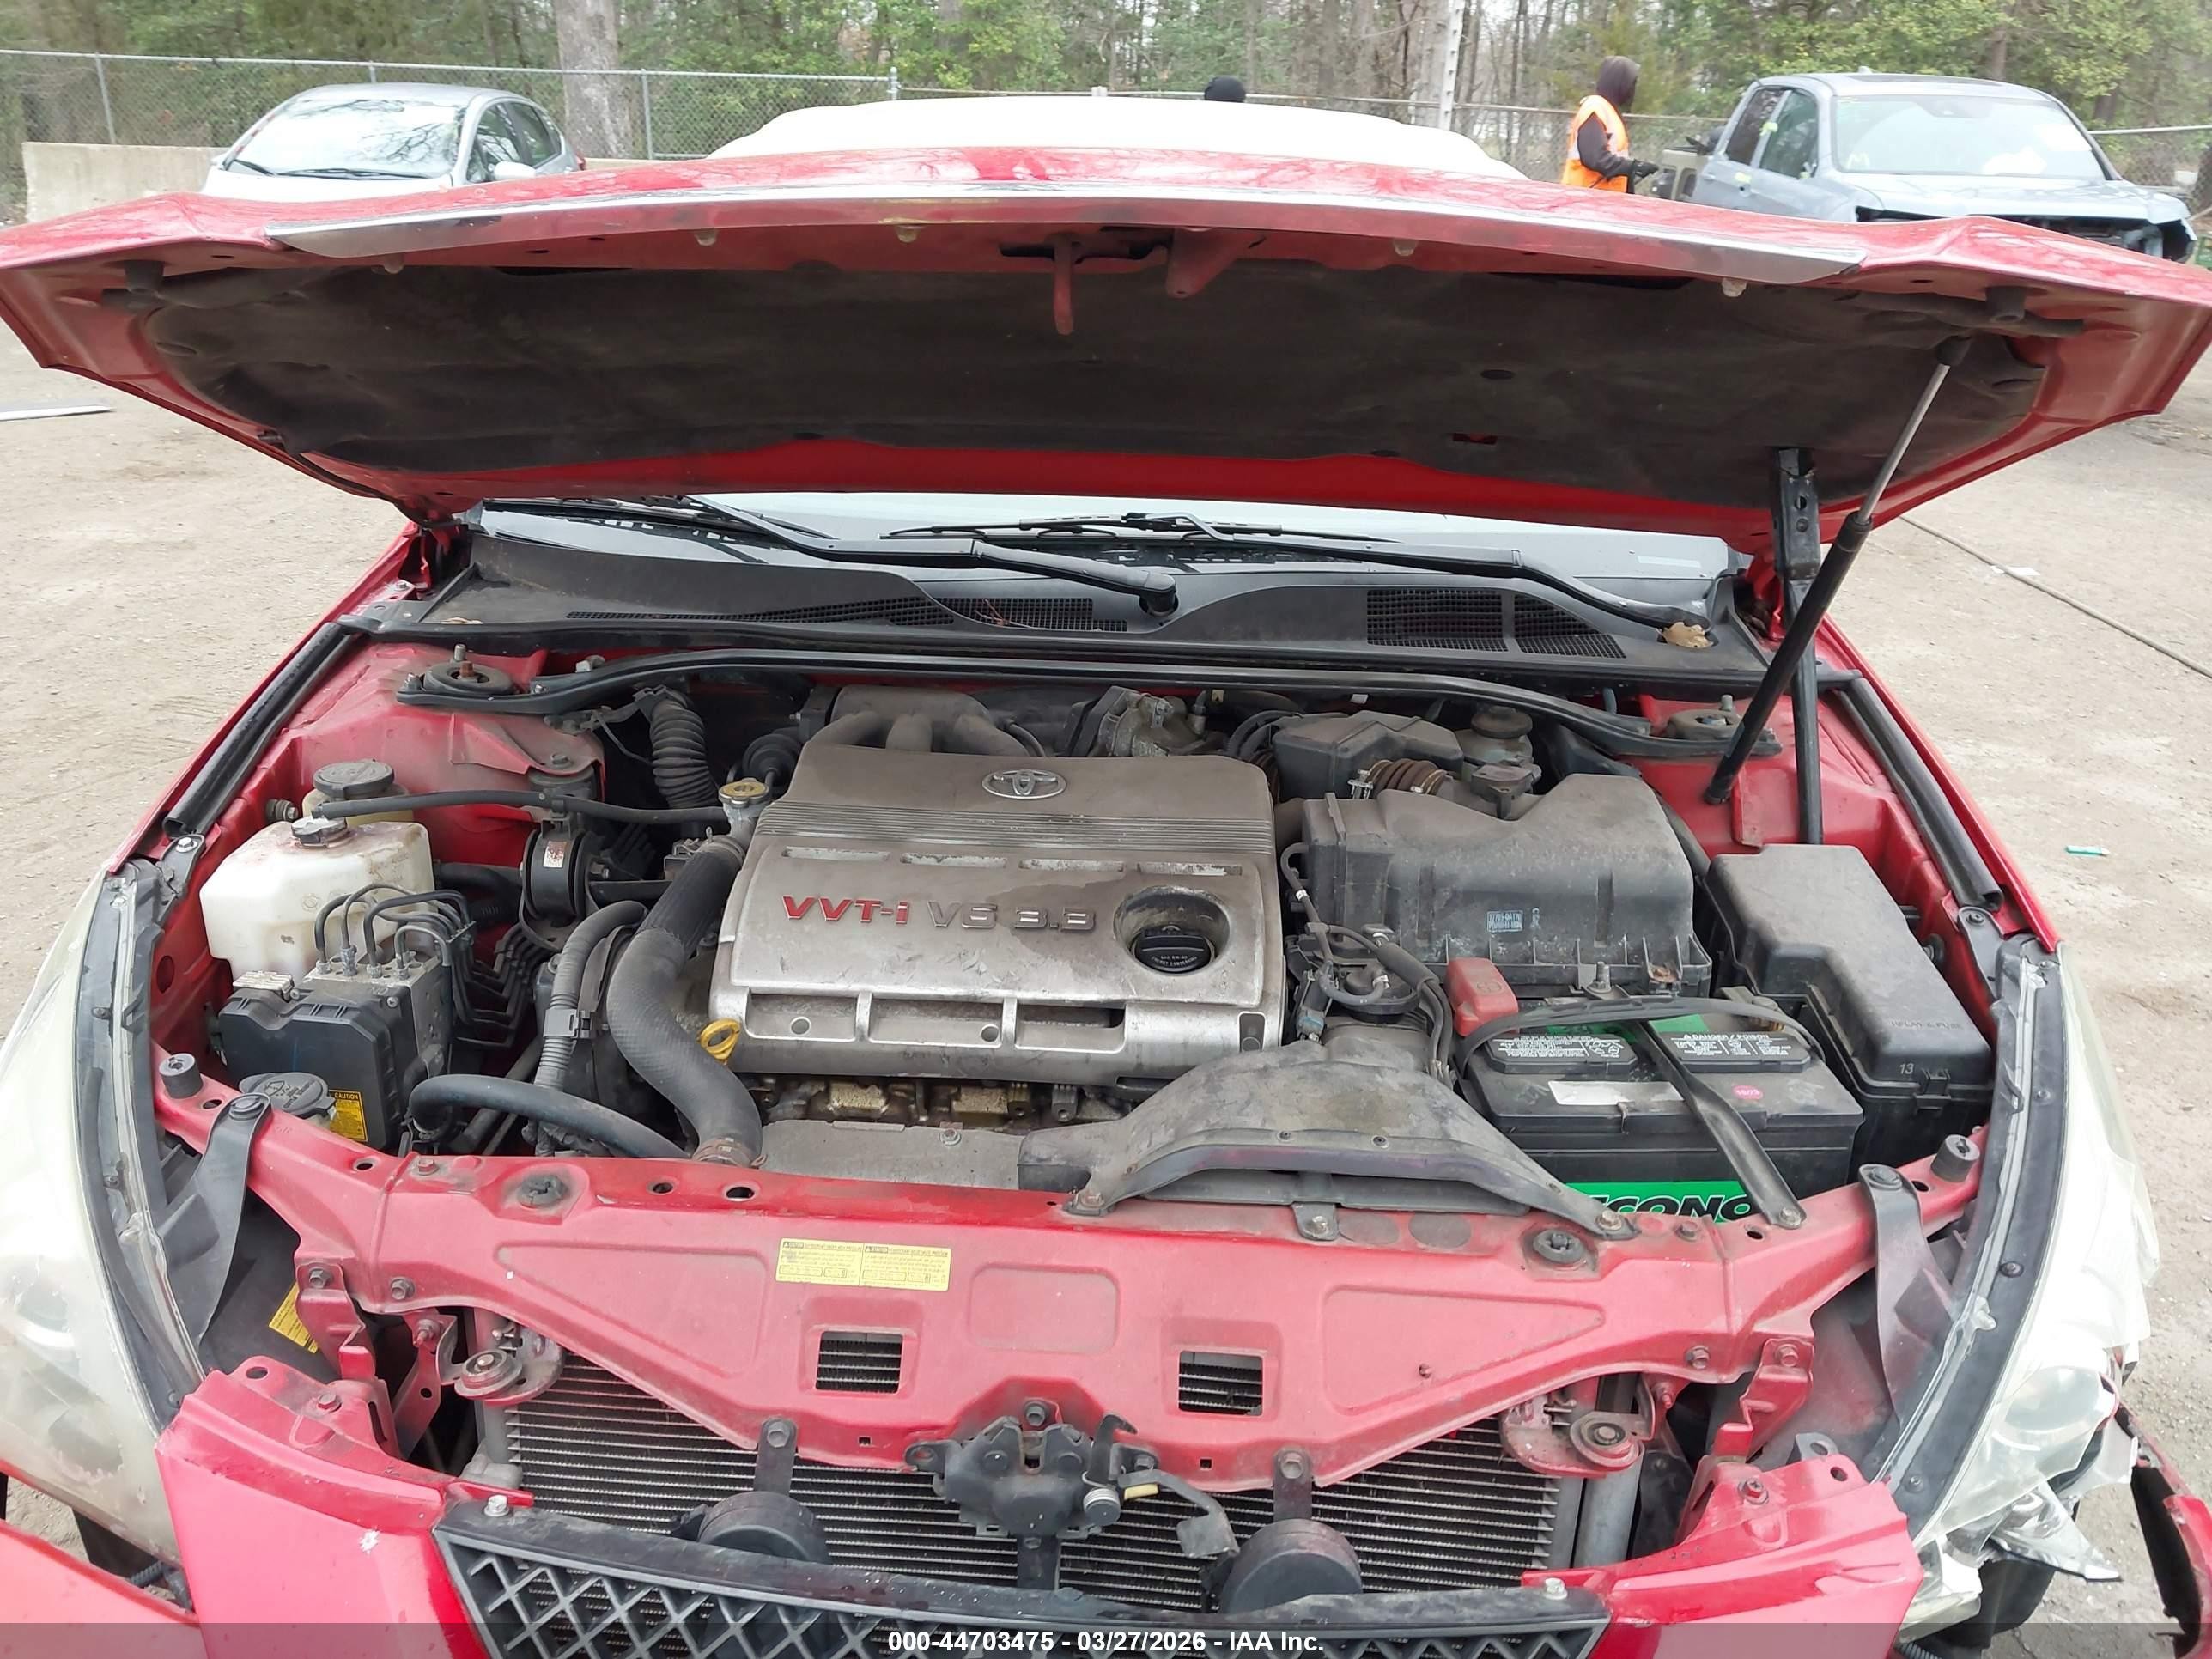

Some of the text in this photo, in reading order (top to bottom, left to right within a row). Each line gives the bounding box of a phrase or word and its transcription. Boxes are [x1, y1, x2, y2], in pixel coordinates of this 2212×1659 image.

[782, 896, 1097, 933] VVT-i V6 3.3
[1899, 1062, 1914, 1074] 13
[333, 1091, 359, 1101] CAUTION
[1589, 1194, 1762, 1223] CONO
